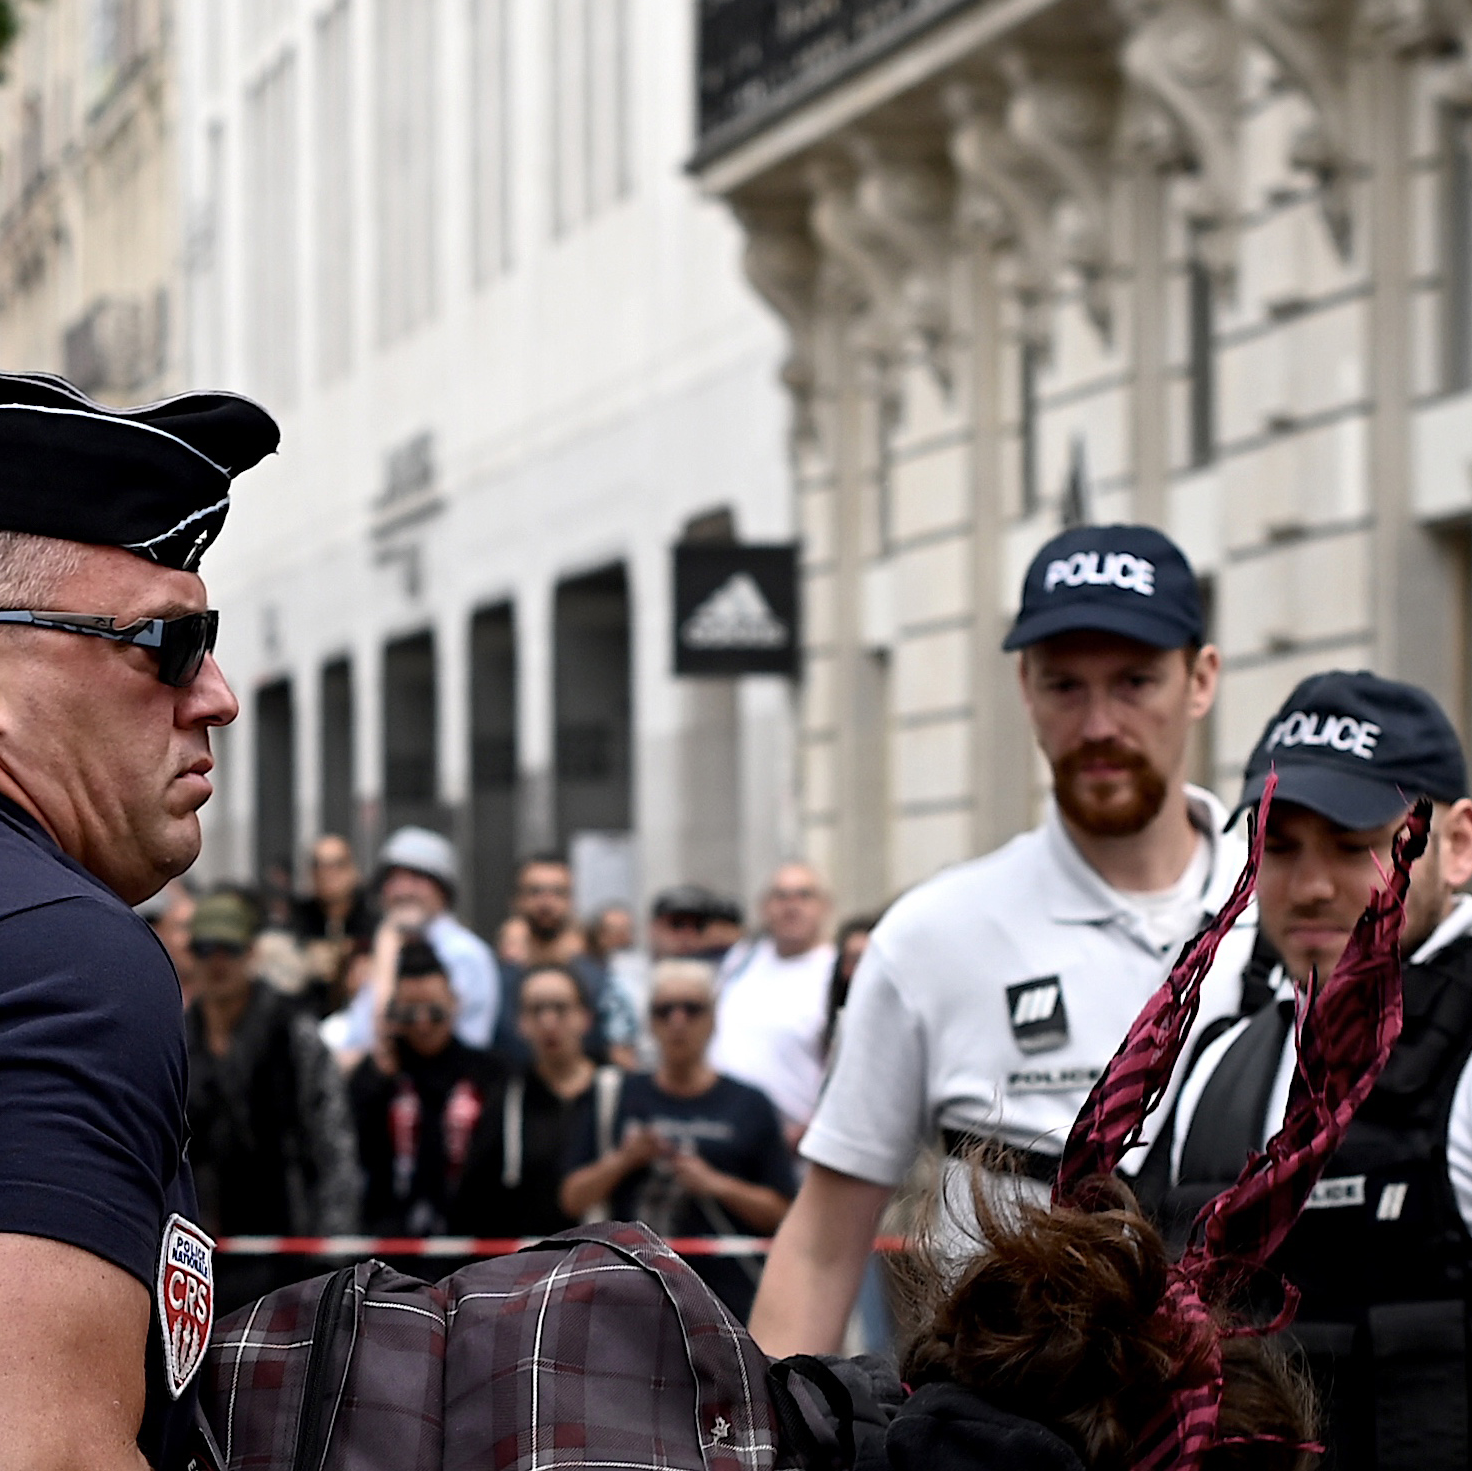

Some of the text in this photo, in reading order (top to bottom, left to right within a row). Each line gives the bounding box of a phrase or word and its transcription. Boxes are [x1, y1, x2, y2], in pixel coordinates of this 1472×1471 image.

[1044, 551, 1156, 597] POLICE
[1267, 711, 1382, 759] POLICE
[172, 1247, 208, 1279] NATIONALE
[177, 1236, 206, 1264] POLICE
[169, 1270, 208, 1325] CRS
